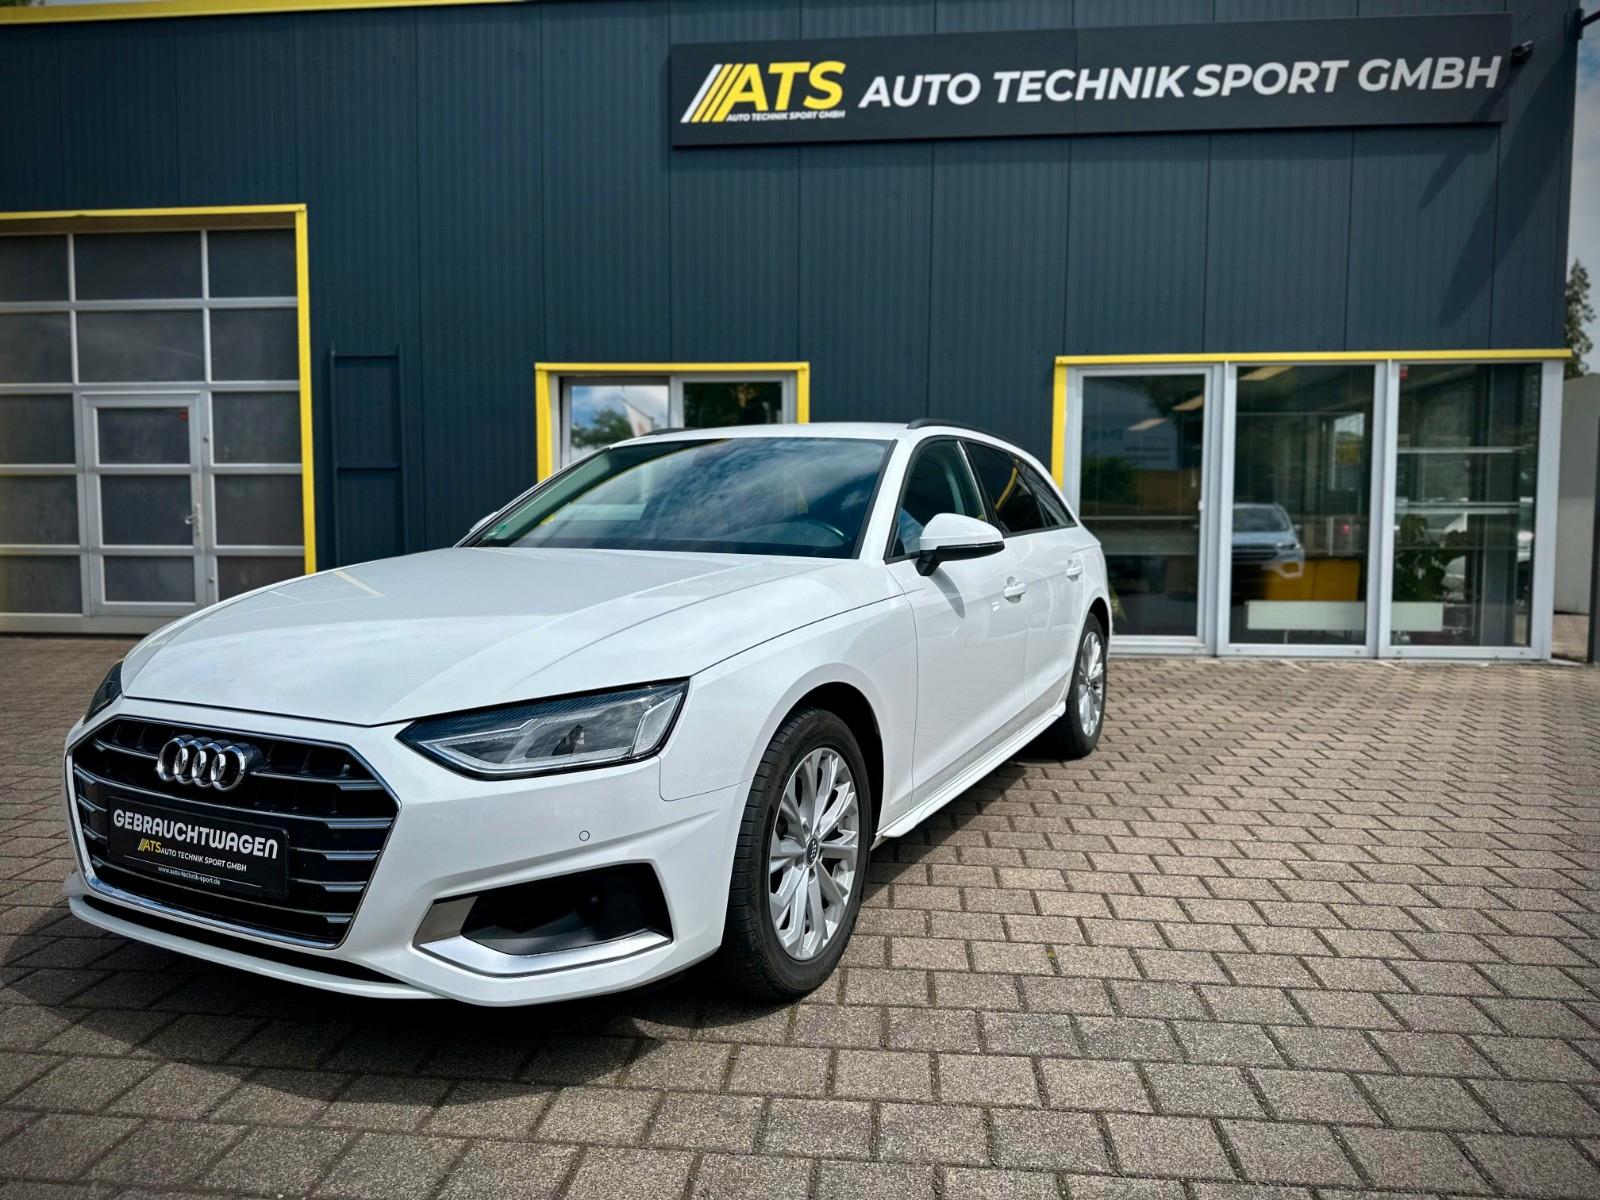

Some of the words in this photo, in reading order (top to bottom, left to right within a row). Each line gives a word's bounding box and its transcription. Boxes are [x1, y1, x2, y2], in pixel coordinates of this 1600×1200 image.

[858, 73, 981, 108] AUTO
[993, 65, 1190, 103] TECHNIK
[1193, 60, 1349, 97] SPORT
[1358, 56, 1502, 91] GMBH
[726, 113, 751, 122] AUTO
[751, 112, 788, 121] TECHNIK
[789, 111, 818, 120] SPORT
[818, 110, 846, 119] GMBH
[113, 808, 278, 859] GEBRAUCHTWAGEN
[178, 851, 204, 864] TECHNIK
[204, 856, 226, 868] SPORT
[226, 861, 247, 872] GMBH
[158, 865, 221, 886] www.auto-technik-sport.de
